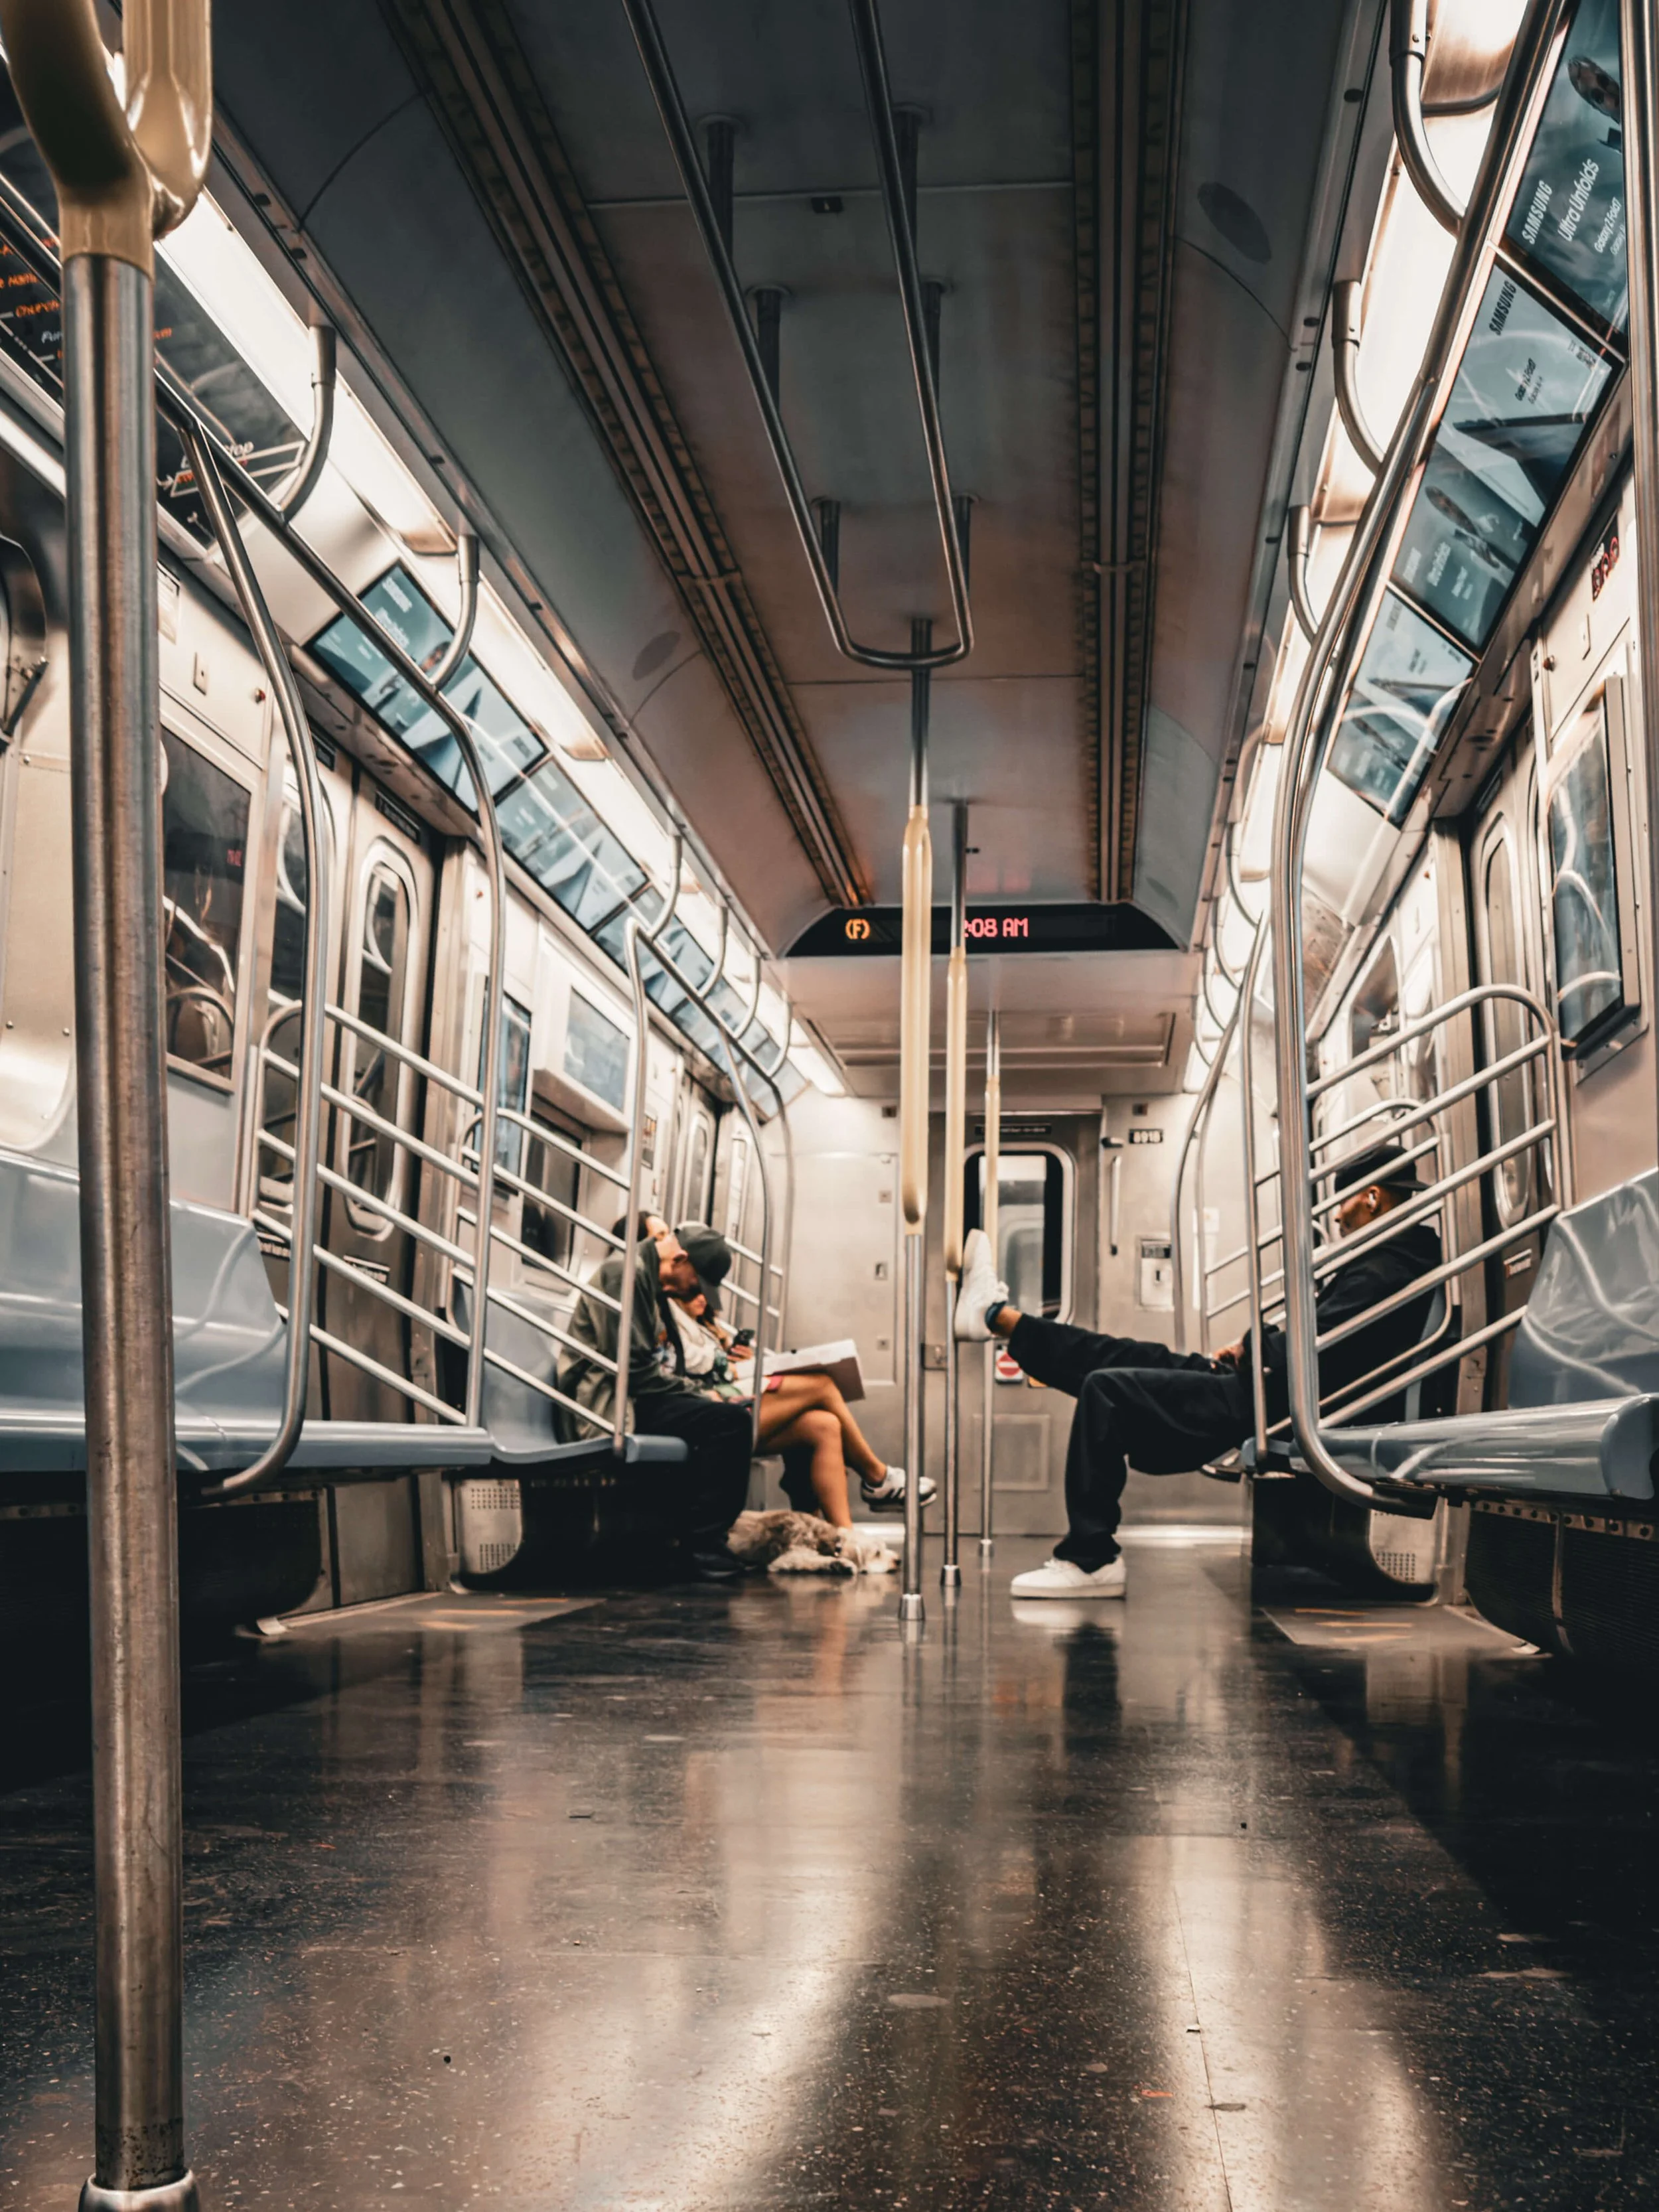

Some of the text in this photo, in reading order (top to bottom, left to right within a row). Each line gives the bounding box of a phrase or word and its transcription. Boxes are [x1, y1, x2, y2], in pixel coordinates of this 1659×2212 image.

[1522, 180, 1553, 245] SAMSUNG
[1558, 159, 1600, 242] Ultra Unfolds
[1488, 280, 1517, 336] SAMSUNG
[1002, 918, 1029, 938] AM
